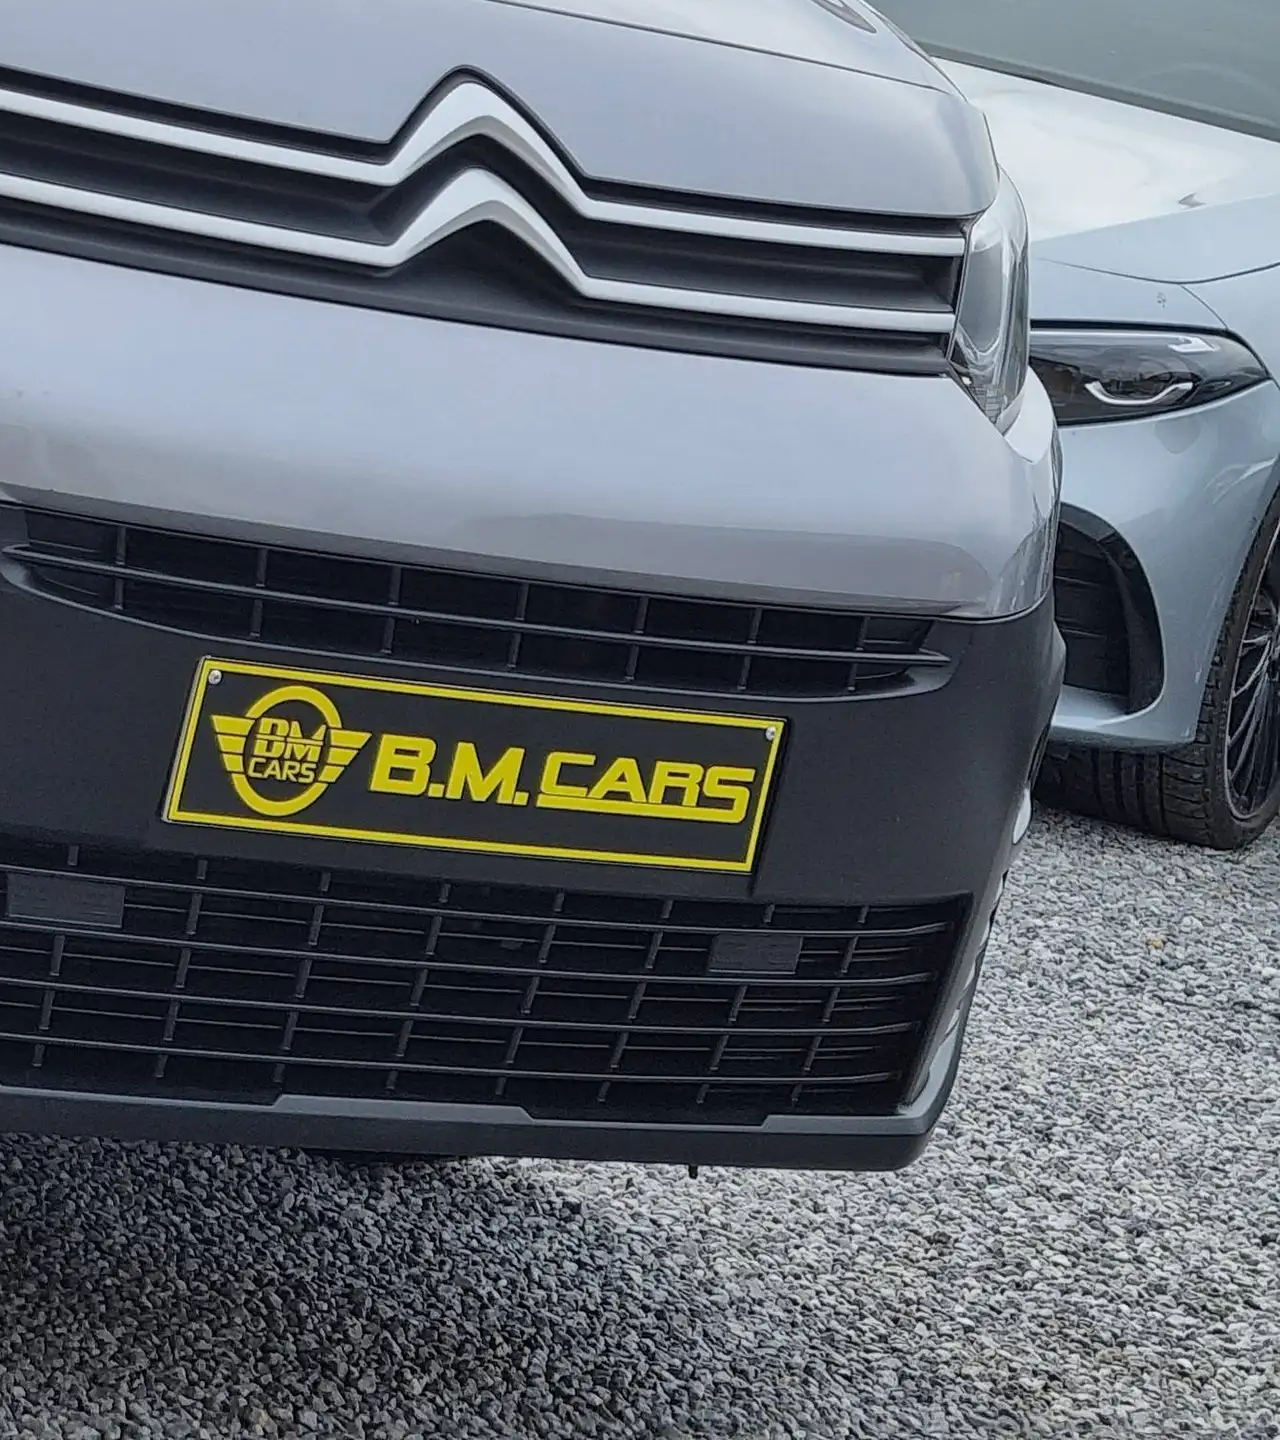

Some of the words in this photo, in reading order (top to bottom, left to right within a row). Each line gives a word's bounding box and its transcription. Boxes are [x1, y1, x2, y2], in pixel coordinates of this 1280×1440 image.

[252, 716, 327, 763] BM
[247, 757, 318, 784] CARS
[369, 733, 757, 823] B.M.CARS
